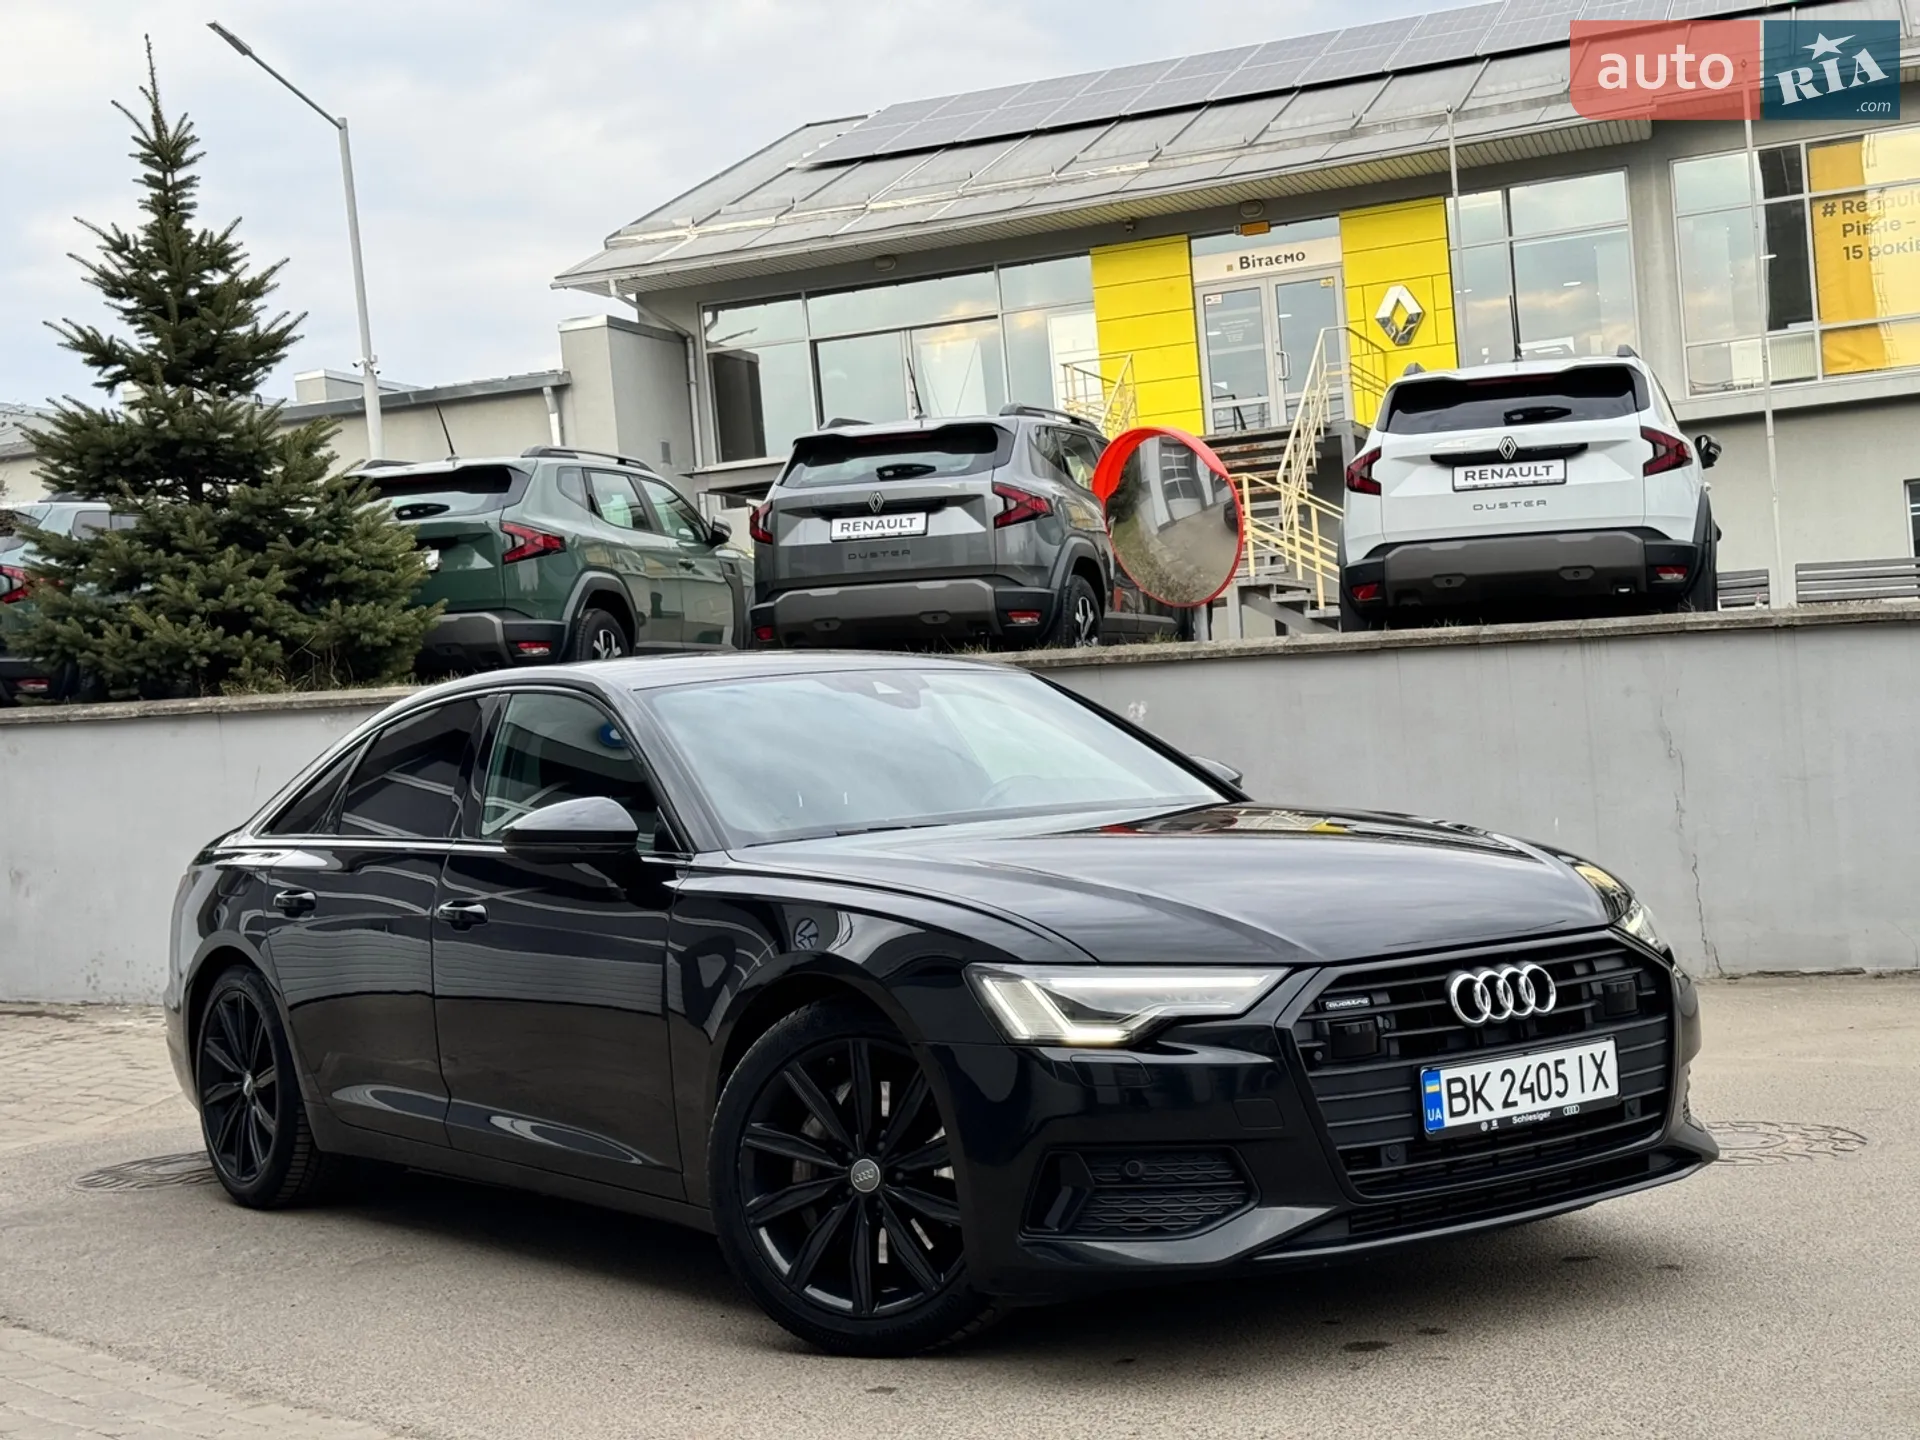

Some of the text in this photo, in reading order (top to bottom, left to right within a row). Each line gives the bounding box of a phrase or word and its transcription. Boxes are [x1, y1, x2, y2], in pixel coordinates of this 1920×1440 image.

[1842, 219, 1902, 238] Рівне
[1238, 251, 1306, 270] Вітаємо
[1842, 244, 1864, 261] 15
[1464, 464, 1554, 482] RENAULT
[1472, 499, 1547, 511] DUSTER
[840, 517, 917, 533] RENAULT
[847, 549, 911, 560] DUSTER
[1499, 1058, 1569, 1110] 2405
[1427, 1107, 1443, 1121] UA
[1512, 1110, 1552, 1125] Schlesiger
